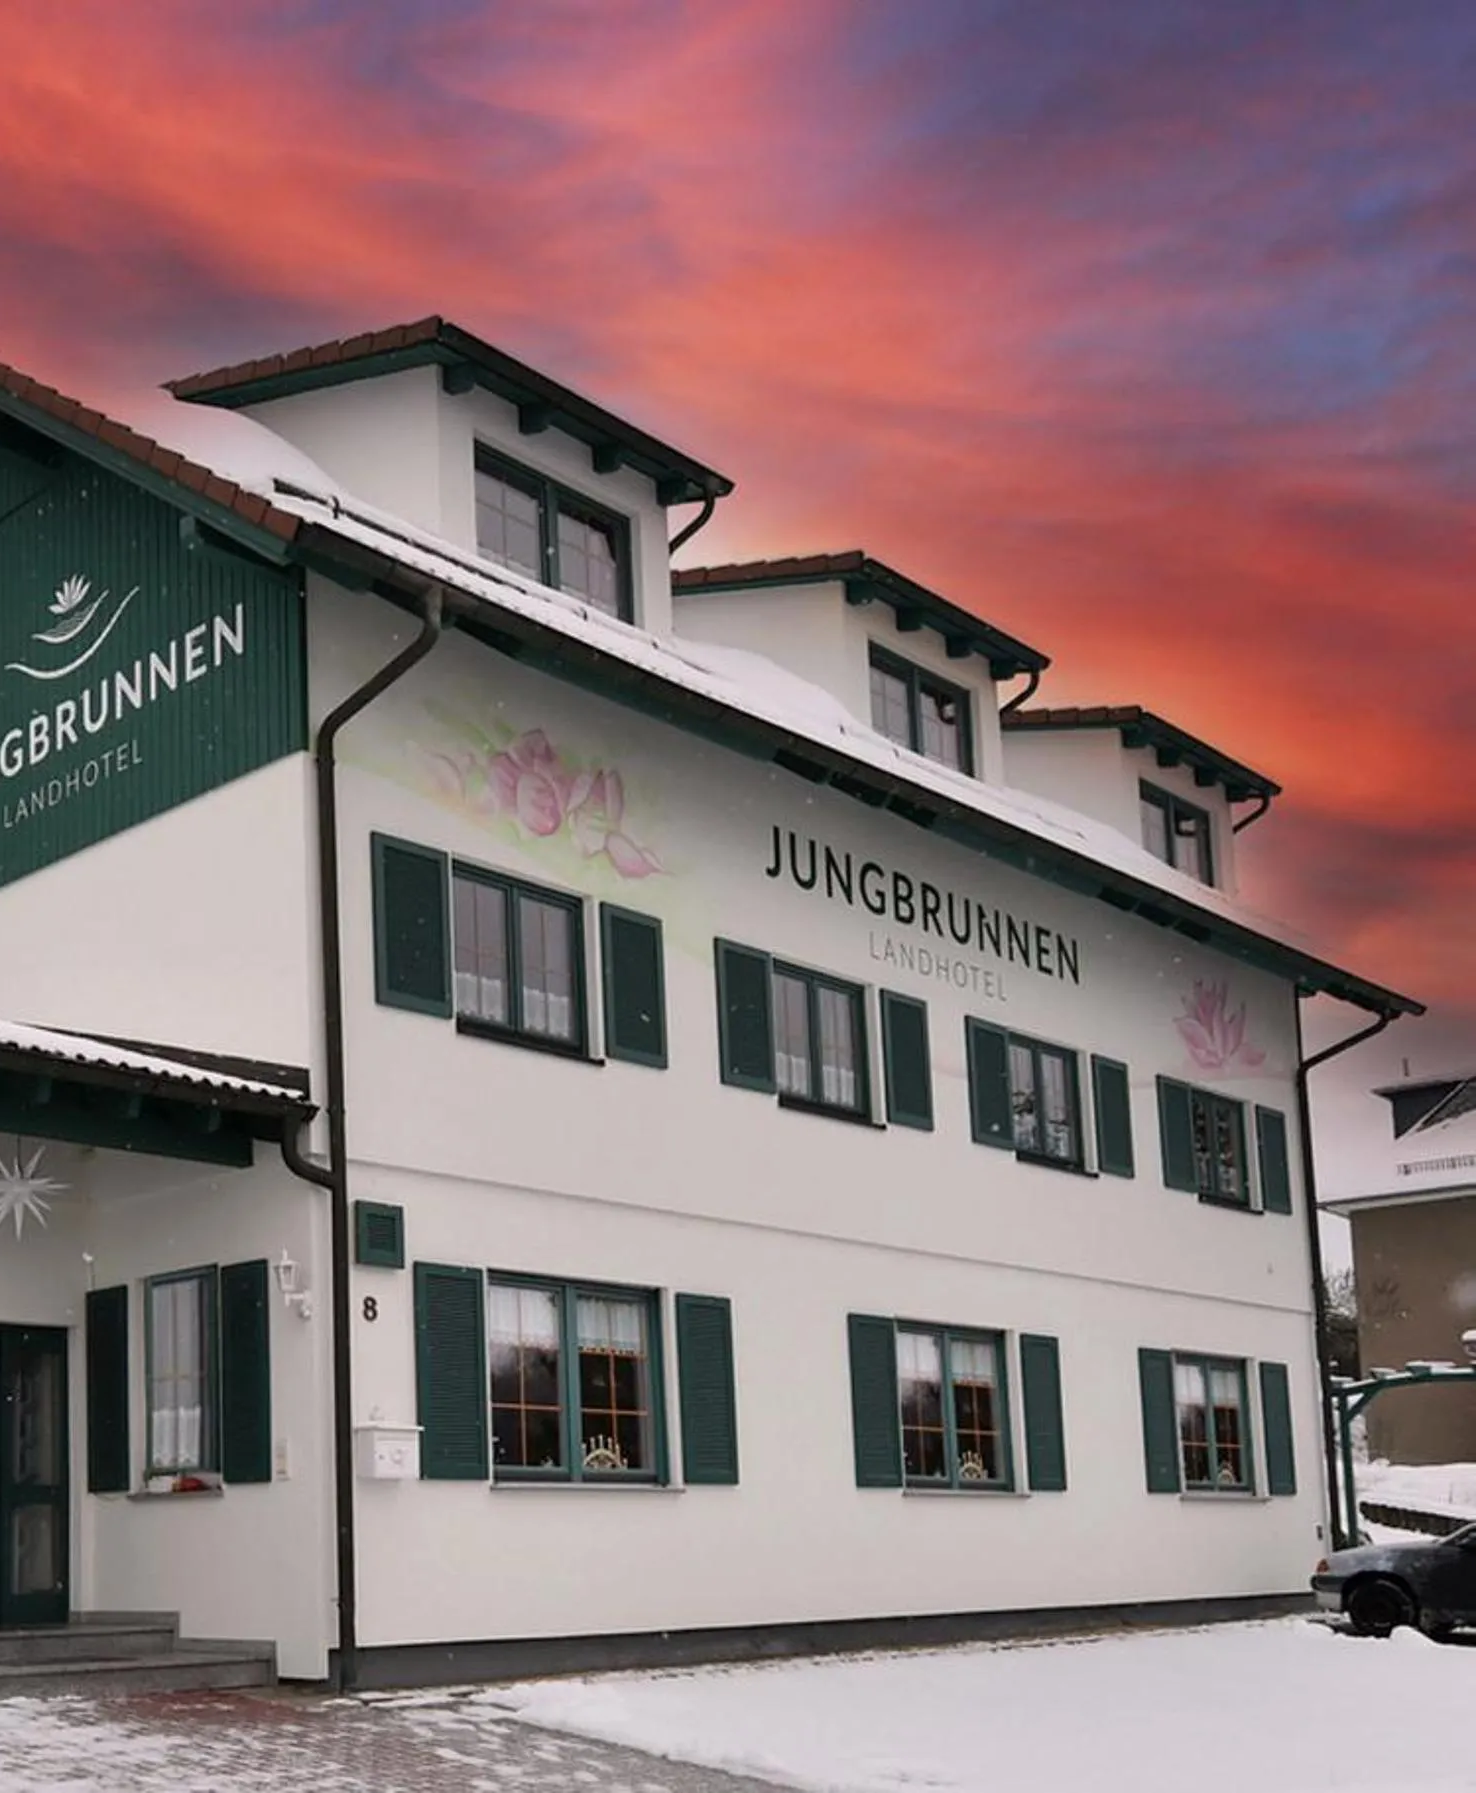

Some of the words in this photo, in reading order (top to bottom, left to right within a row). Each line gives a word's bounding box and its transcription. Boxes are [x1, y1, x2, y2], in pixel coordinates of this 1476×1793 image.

[3, 739, 143, 829] LANDHOTEL
[766, 825, 1080, 985] JUNGBRUNNEN
[869, 931, 1008, 1002] LANDHOTEL
[363, 1296, 378, 1322] 8
